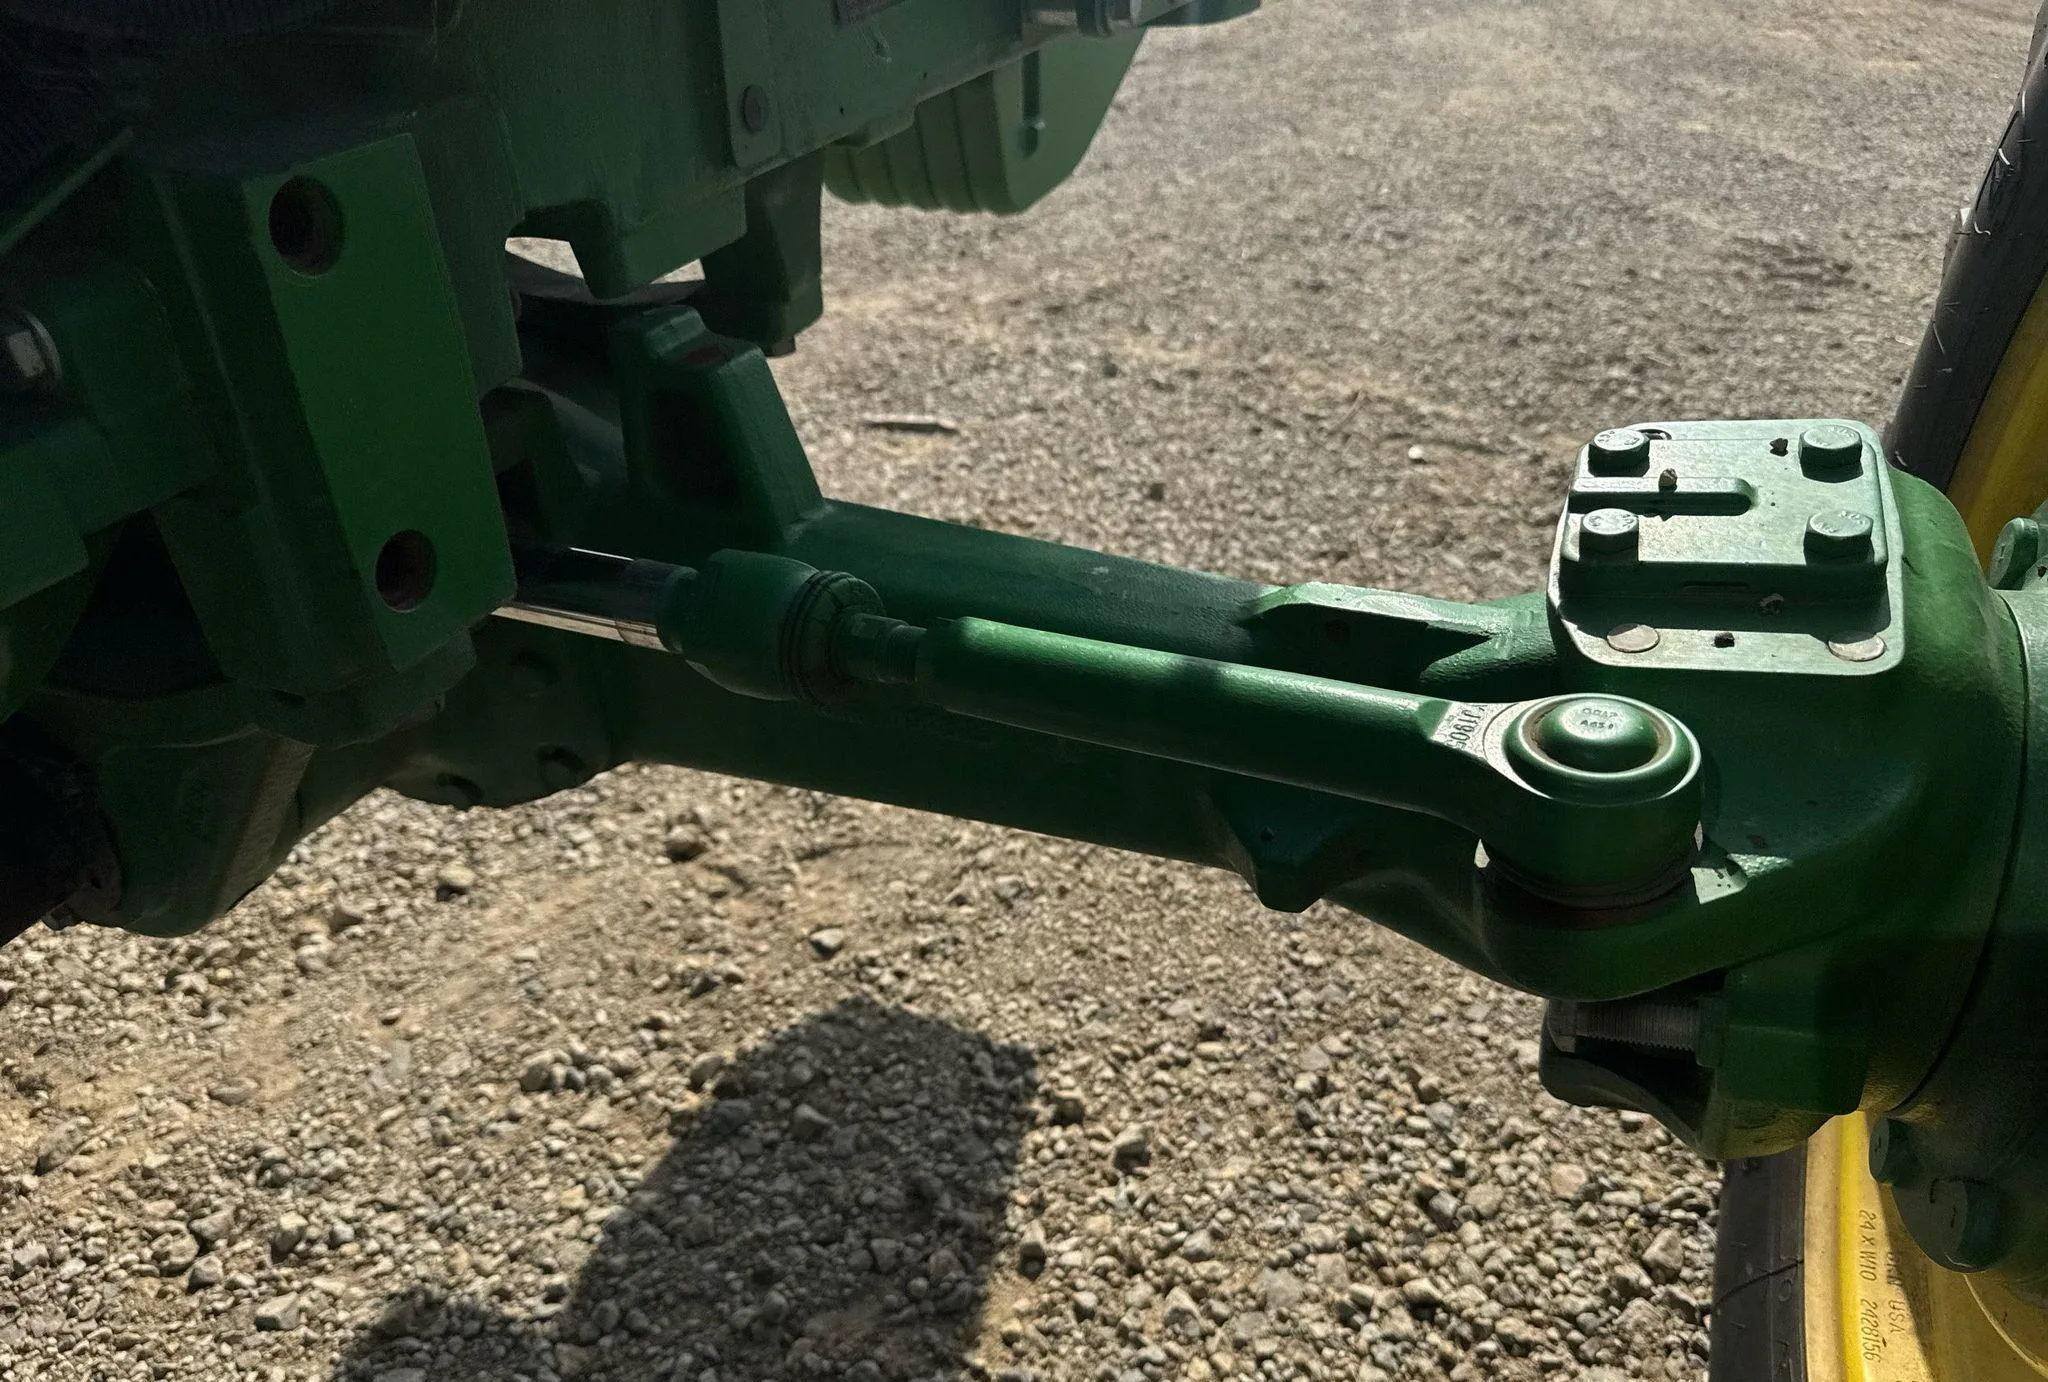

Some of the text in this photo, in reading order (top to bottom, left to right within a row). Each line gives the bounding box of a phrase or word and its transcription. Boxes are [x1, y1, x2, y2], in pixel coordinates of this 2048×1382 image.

[1859, 1209, 1877, 1231] 24
[1859, 1250, 1877, 1282] W10
[1860, 1298, 1882, 1363] 2428156
[1888, 1299, 1906, 1334] USA
